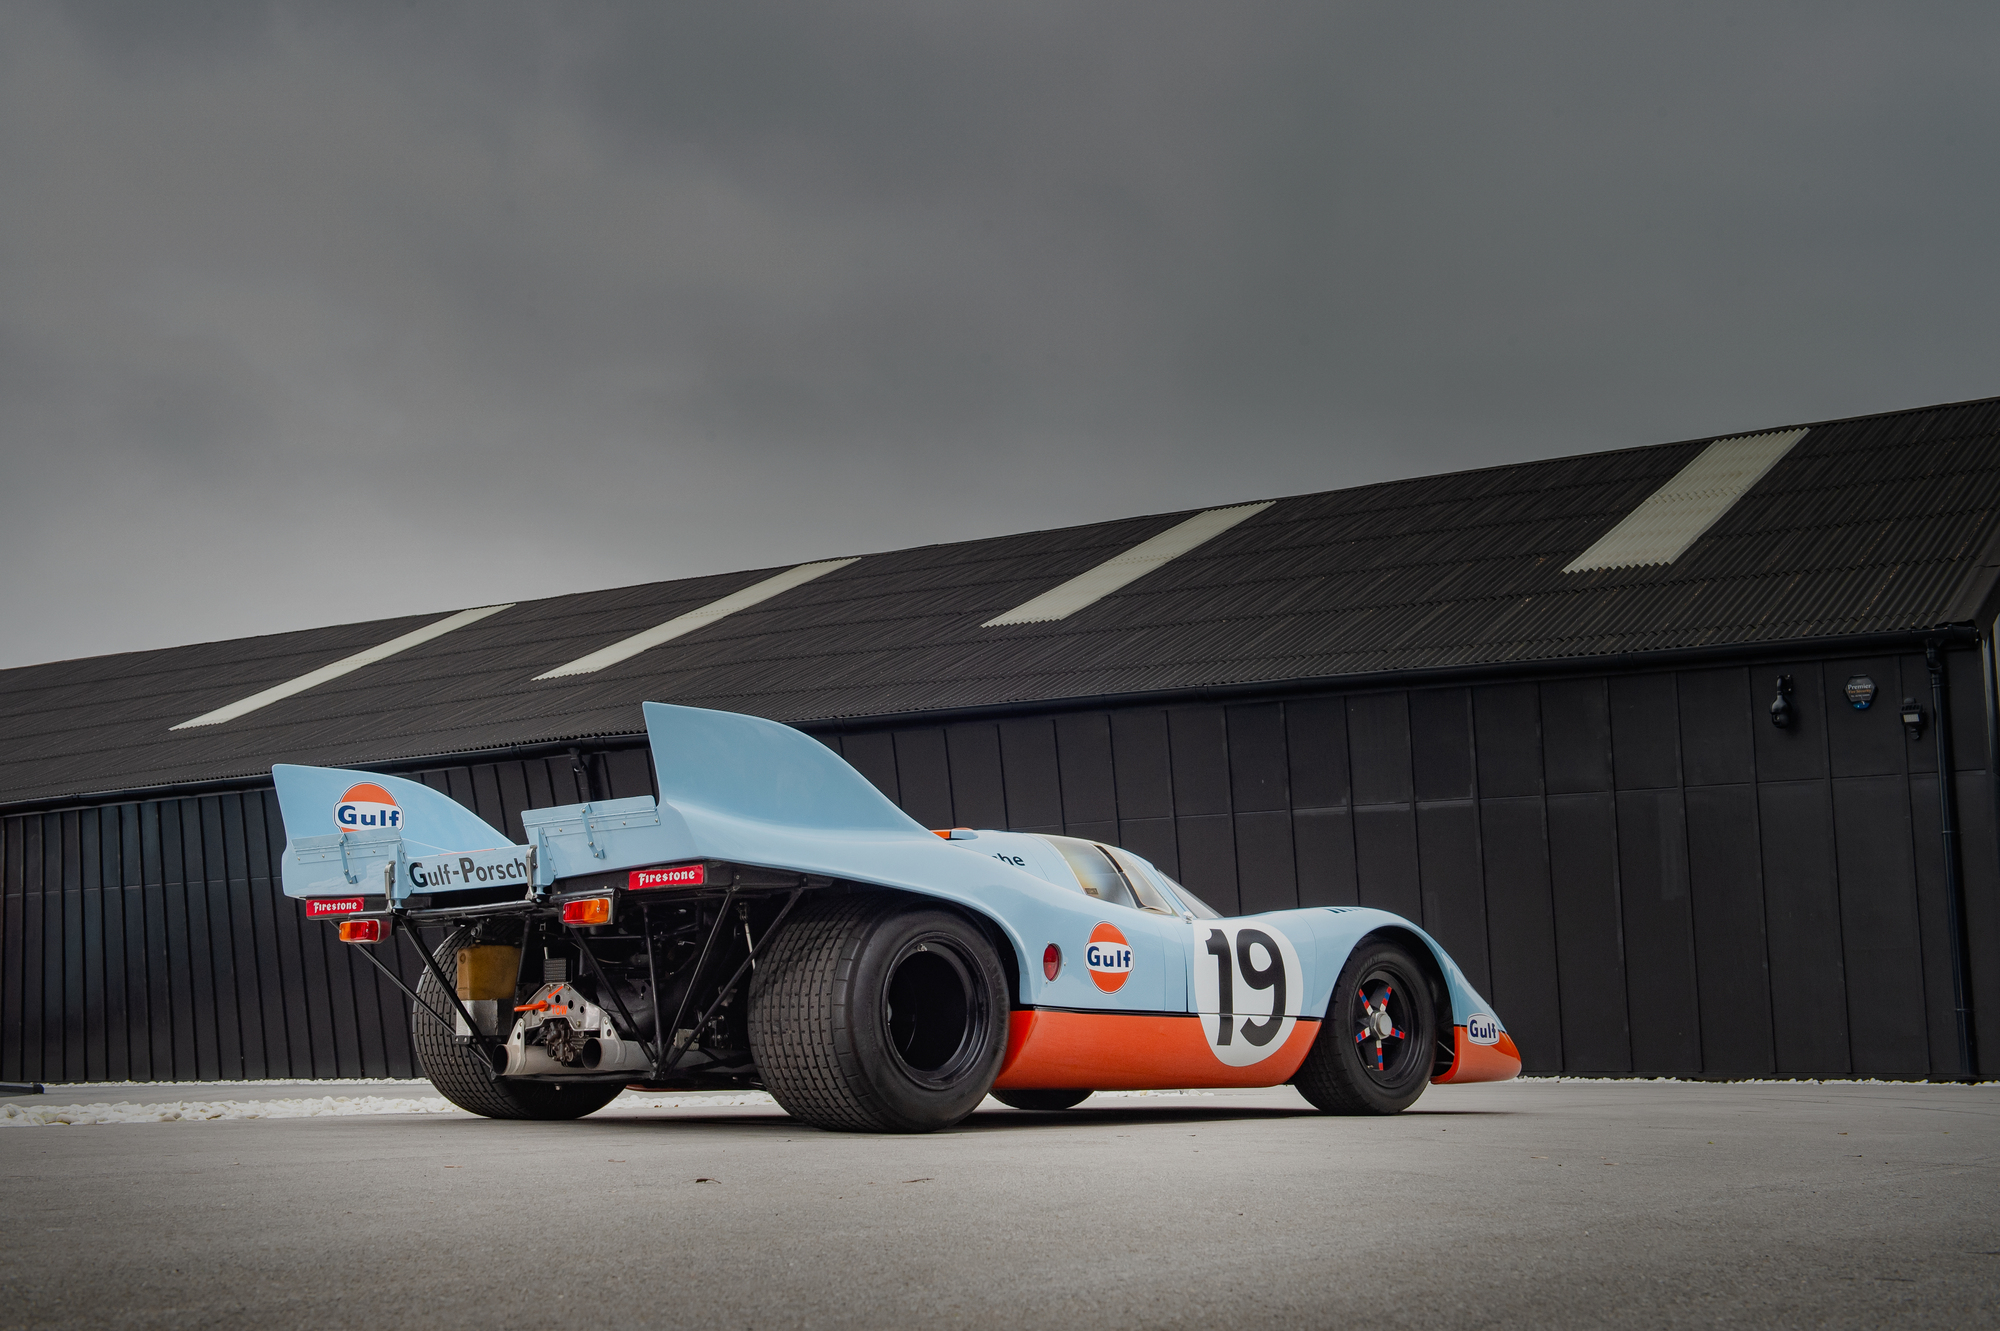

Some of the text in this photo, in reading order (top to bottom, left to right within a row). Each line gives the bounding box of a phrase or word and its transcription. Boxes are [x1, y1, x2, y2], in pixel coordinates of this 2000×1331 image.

[337, 805, 400, 827] Gulf
[409, 857, 528, 888] Gulf-Porsch
[638, 870, 695, 886] Firestone
[313, 901, 357, 913] Firestone
[1087, 945, 1131, 968] Gulf
[1205, 928, 1287, 1047] 19
[551, 1004, 568, 1015] TOW
[1469, 1019, 1496, 1039] Gulf
